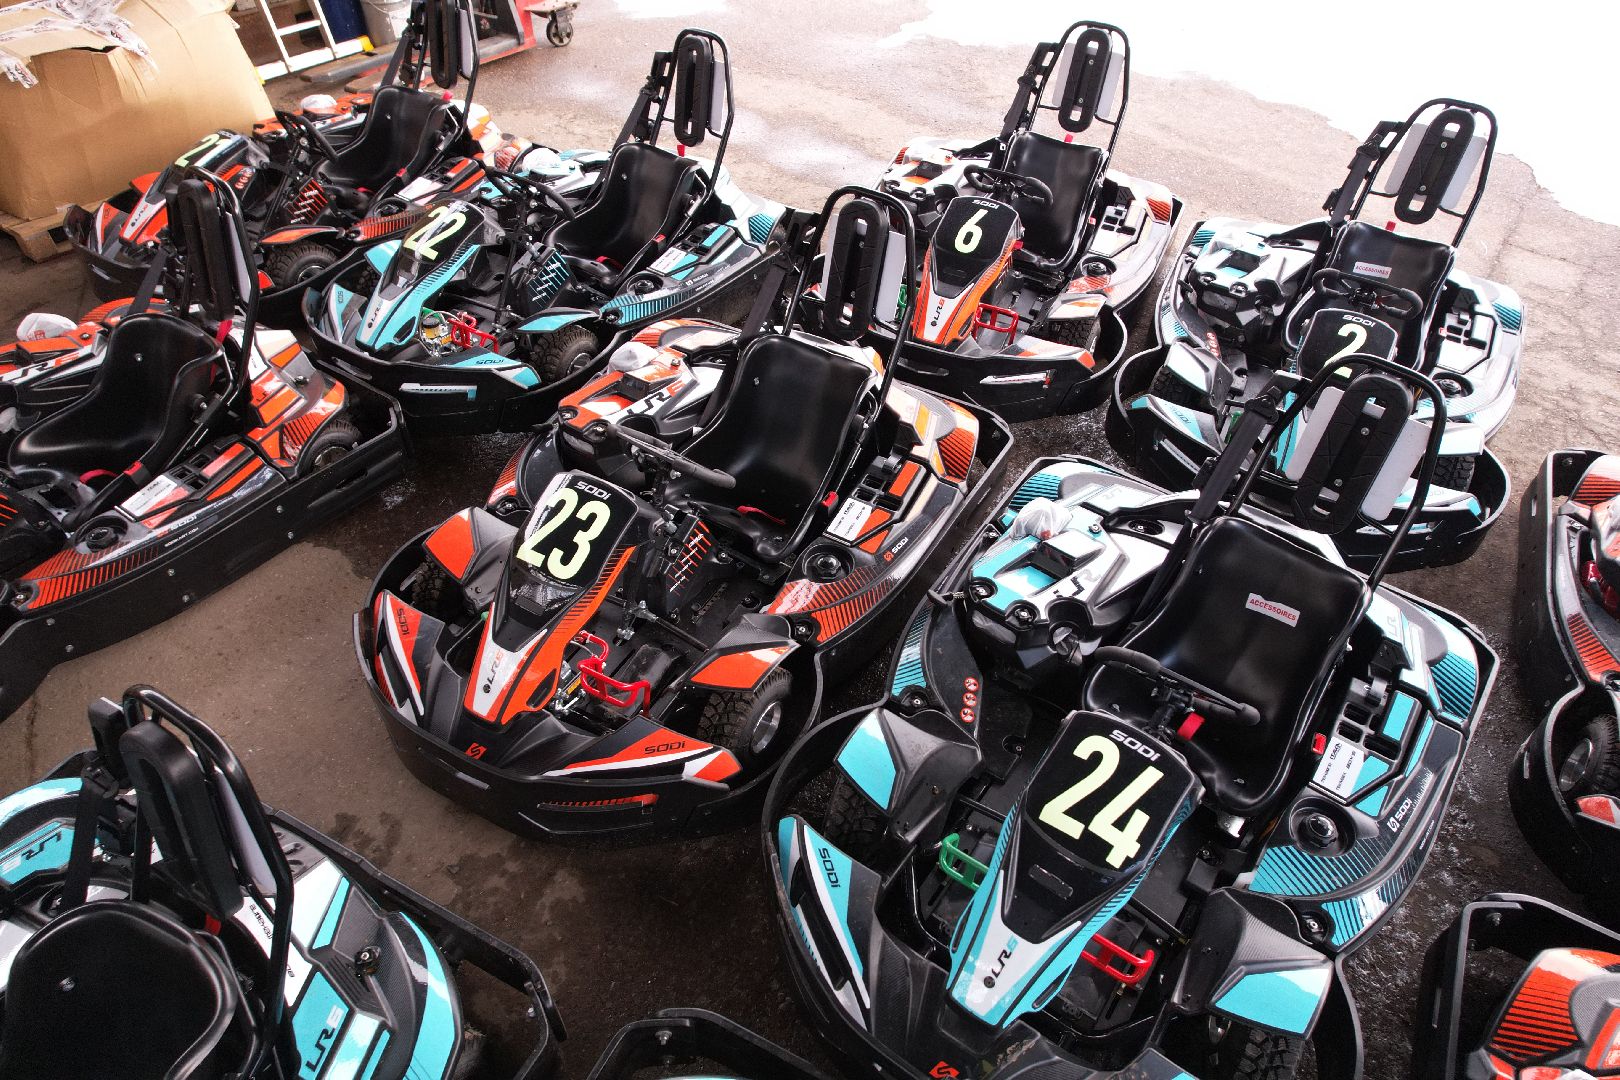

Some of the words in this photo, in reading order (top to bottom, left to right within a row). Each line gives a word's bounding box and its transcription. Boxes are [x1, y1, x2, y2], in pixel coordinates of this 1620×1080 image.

[174, 133, 233, 168] 21
[972, 200, 1000, 210] SODI
[403, 206, 467, 261] 22
[954, 208, 989, 254] 6
[1342, 314, 1376, 328] SODI
[1323, 323, 1368, 379] 2
[575, 481, 612, 500] SODI
[516, 487, 611, 580] 23
[891, 536, 909, 554] SODI
[1249, 598, 1297, 621] ACCESSOIRES
[644, 741, 687, 755] SODI
[1109, 729, 1161, 762] SODI
[1038, 734, 1165, 870] 24
[1394, 797, 1413, 821] SODI
[818, 847, 842, 888] SODI
